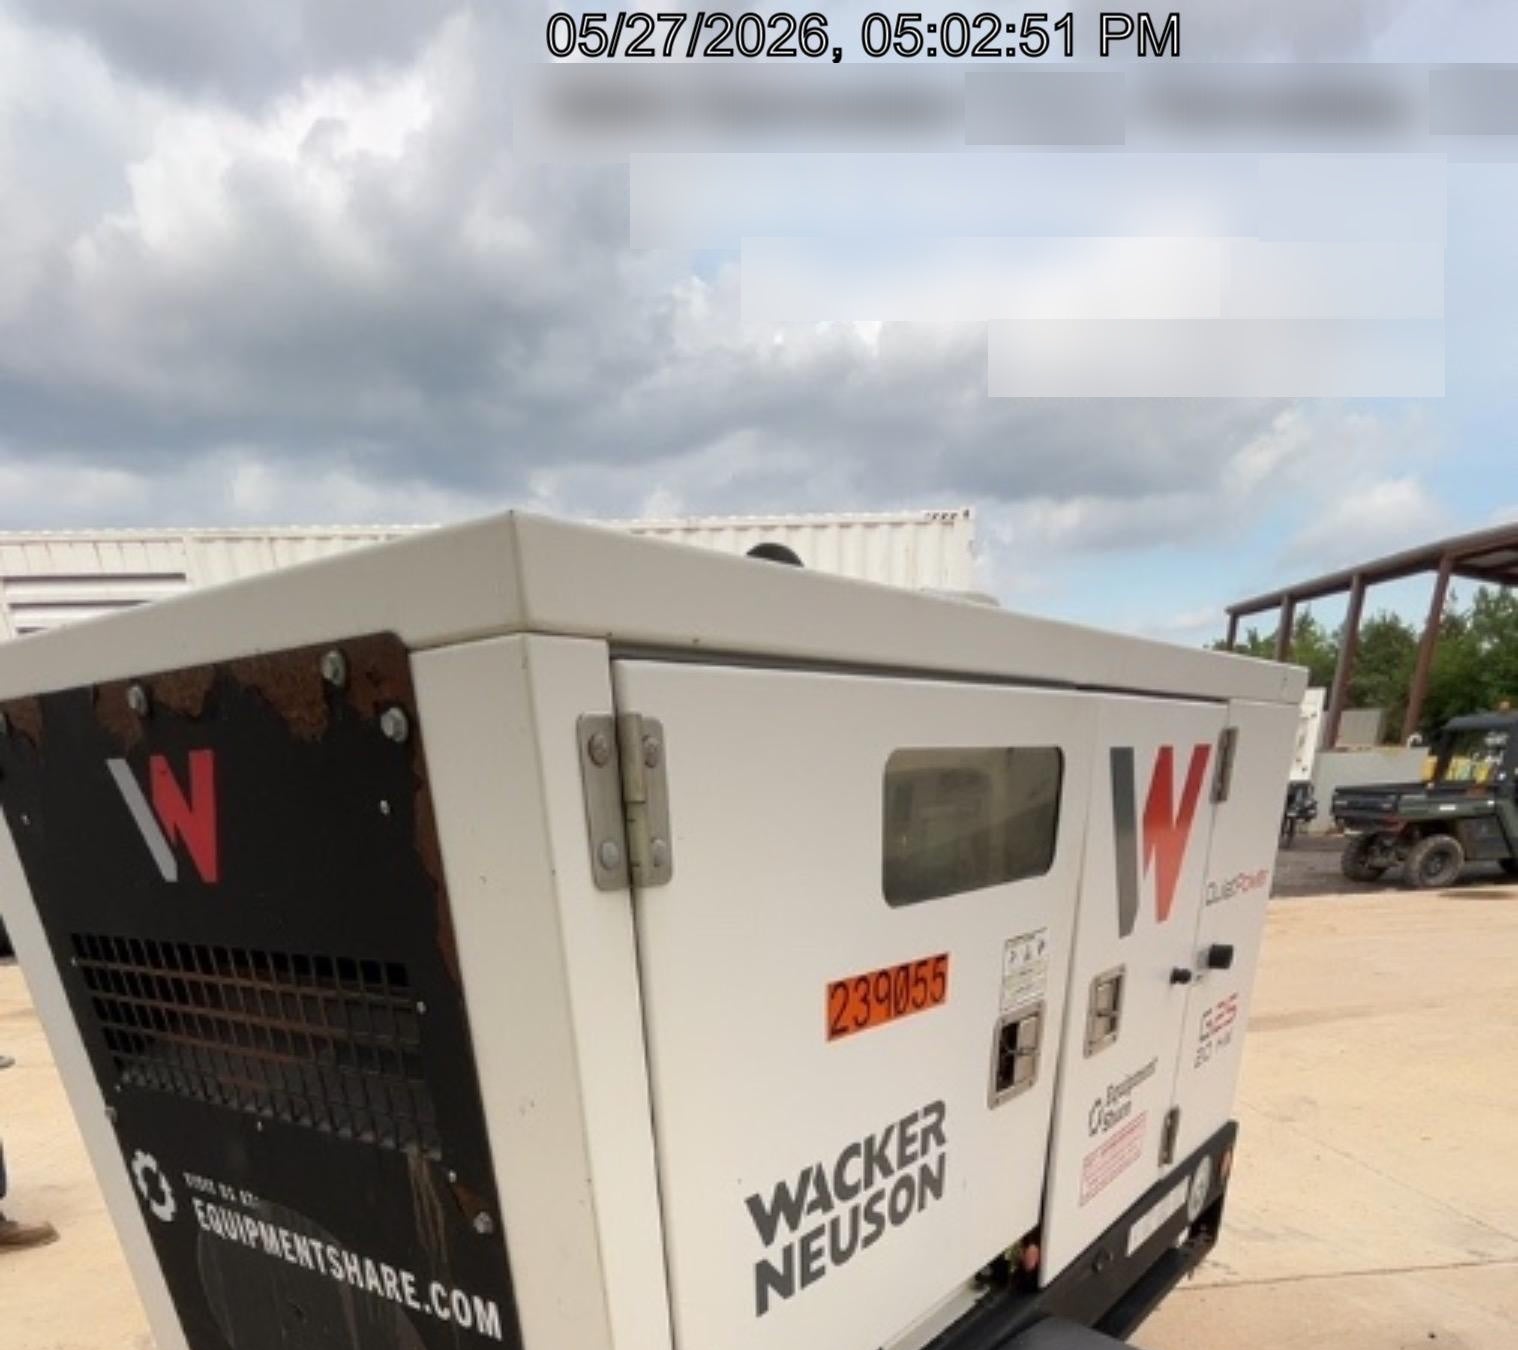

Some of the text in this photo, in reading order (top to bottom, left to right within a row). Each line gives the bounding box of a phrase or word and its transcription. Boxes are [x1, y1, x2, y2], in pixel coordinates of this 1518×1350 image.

[829, 952, 948, 1038] 239055
[745, 1099, 947, 1248] WACKER
[755, 1151, 946, 1318] NEUSON
[192, 1196, 502, 1342] EQUIPMENTSHARE.COM
